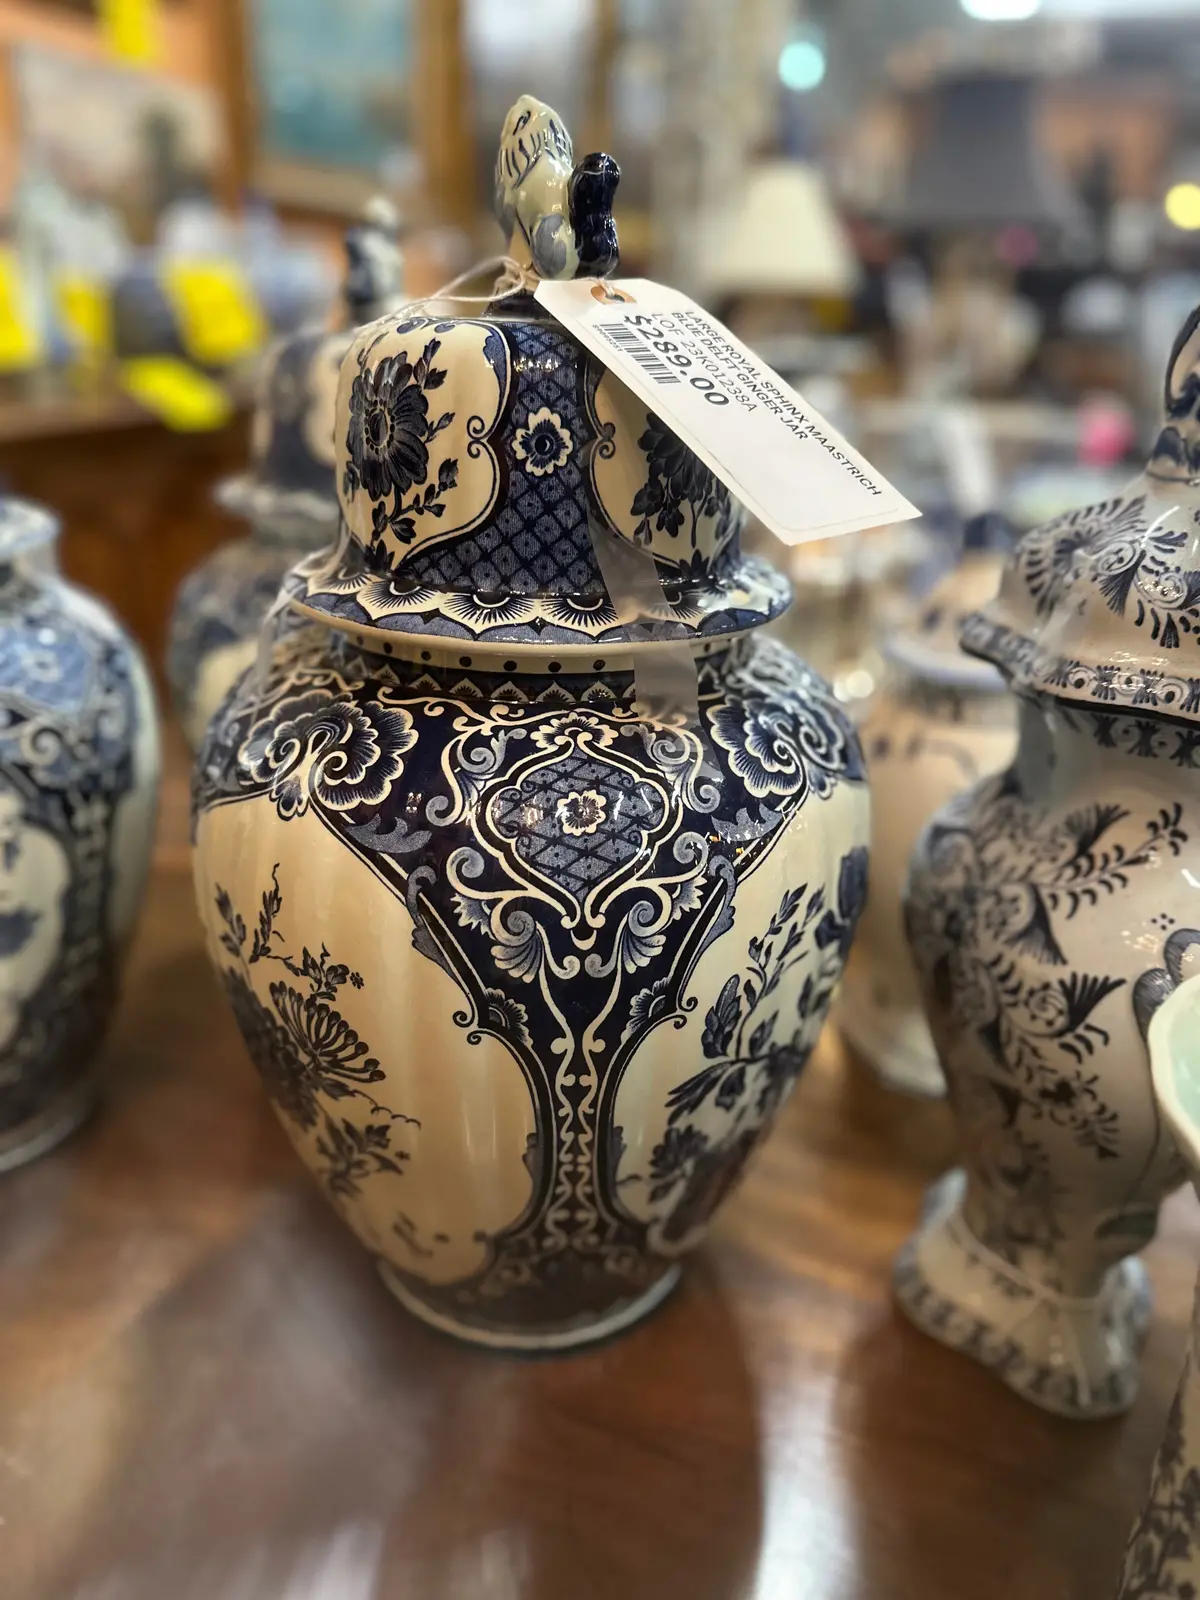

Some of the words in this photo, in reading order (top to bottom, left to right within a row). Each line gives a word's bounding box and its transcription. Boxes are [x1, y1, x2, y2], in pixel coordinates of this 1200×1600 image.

[624, 315, 730, 406] $289.00
[651, 313, 684, 336] LOF
[680, 341, 758, 412] 23K01238A
[671, 312, 705, 338] BLUE
[700, 339, 740, 371] DELFT
[736, 373, 783, 415] GINGER
[780, 416, 809, 440] JAR
[685, 311, 725, 343] LARGE
[721, 345, 762, 380] ROYAL
[761, 381, 809, 424] SPHINX
[805, 425, 882, 496] MAASTRICH
